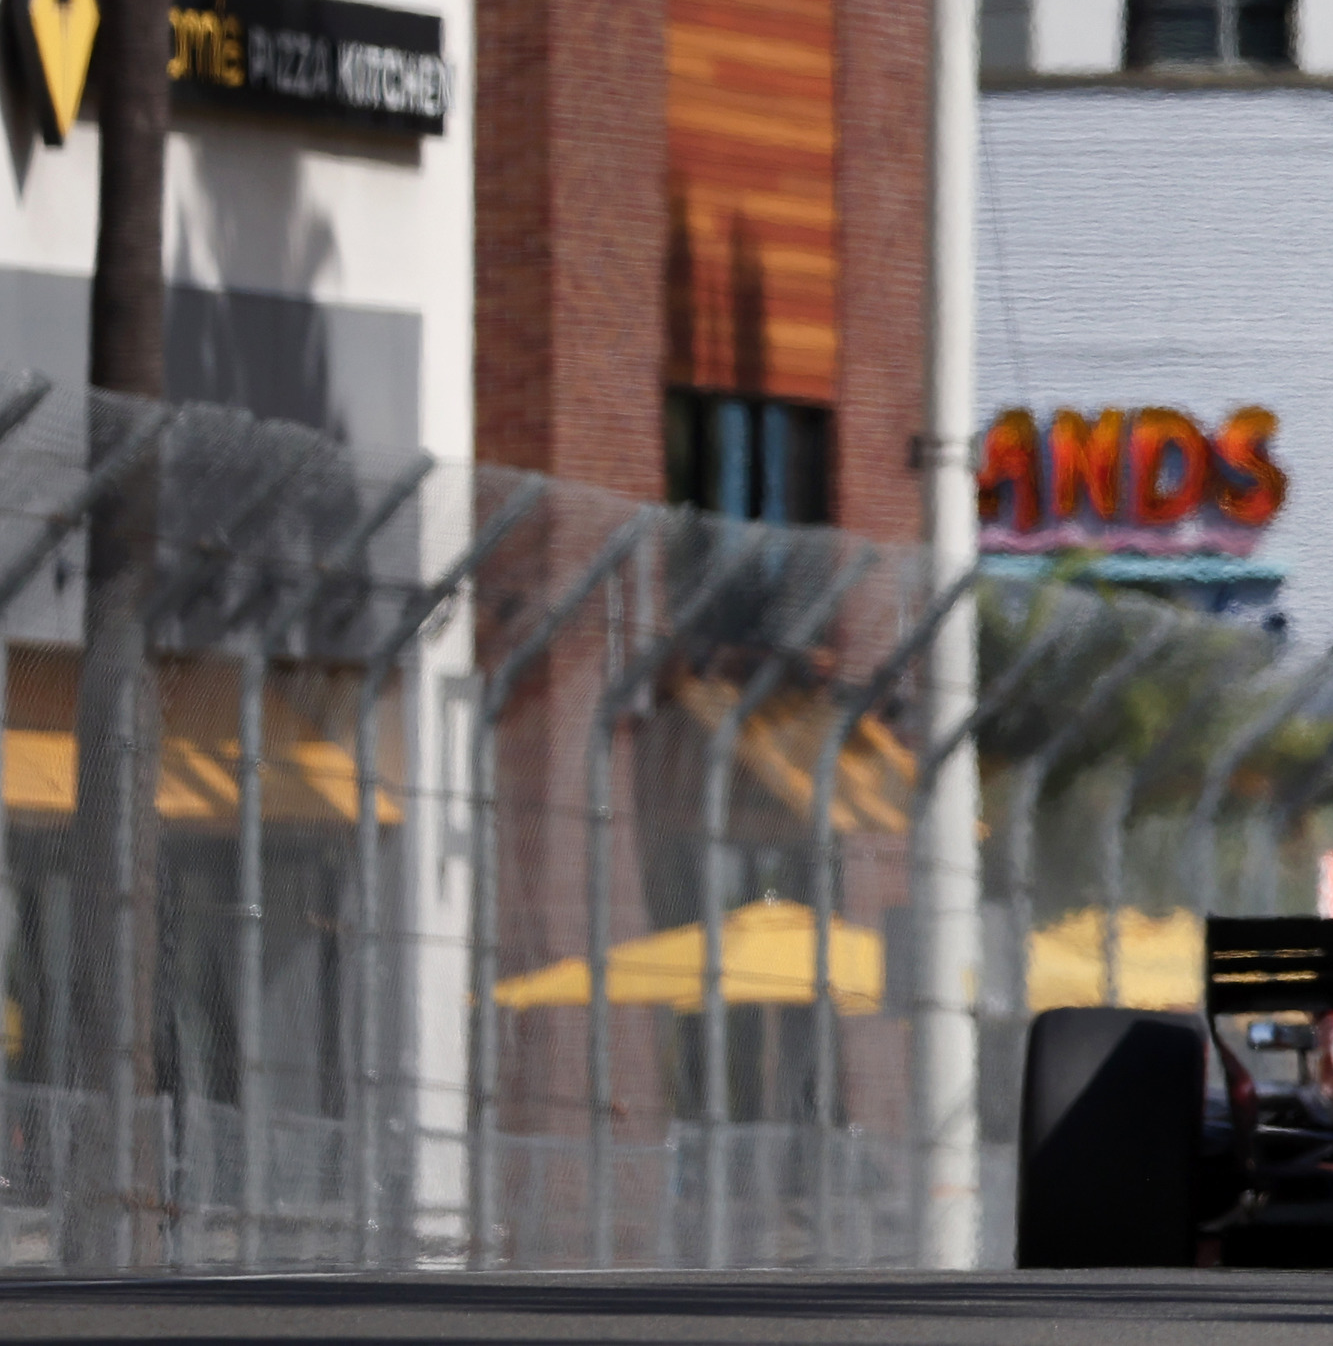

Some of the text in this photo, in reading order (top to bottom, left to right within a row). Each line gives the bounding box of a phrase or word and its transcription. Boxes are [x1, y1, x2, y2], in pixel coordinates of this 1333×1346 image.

[249, 25, 329, 98] PIZZA
[337, 39, 454, 118] KITCHEN
[978, 406, 1287, 531] ANDS
